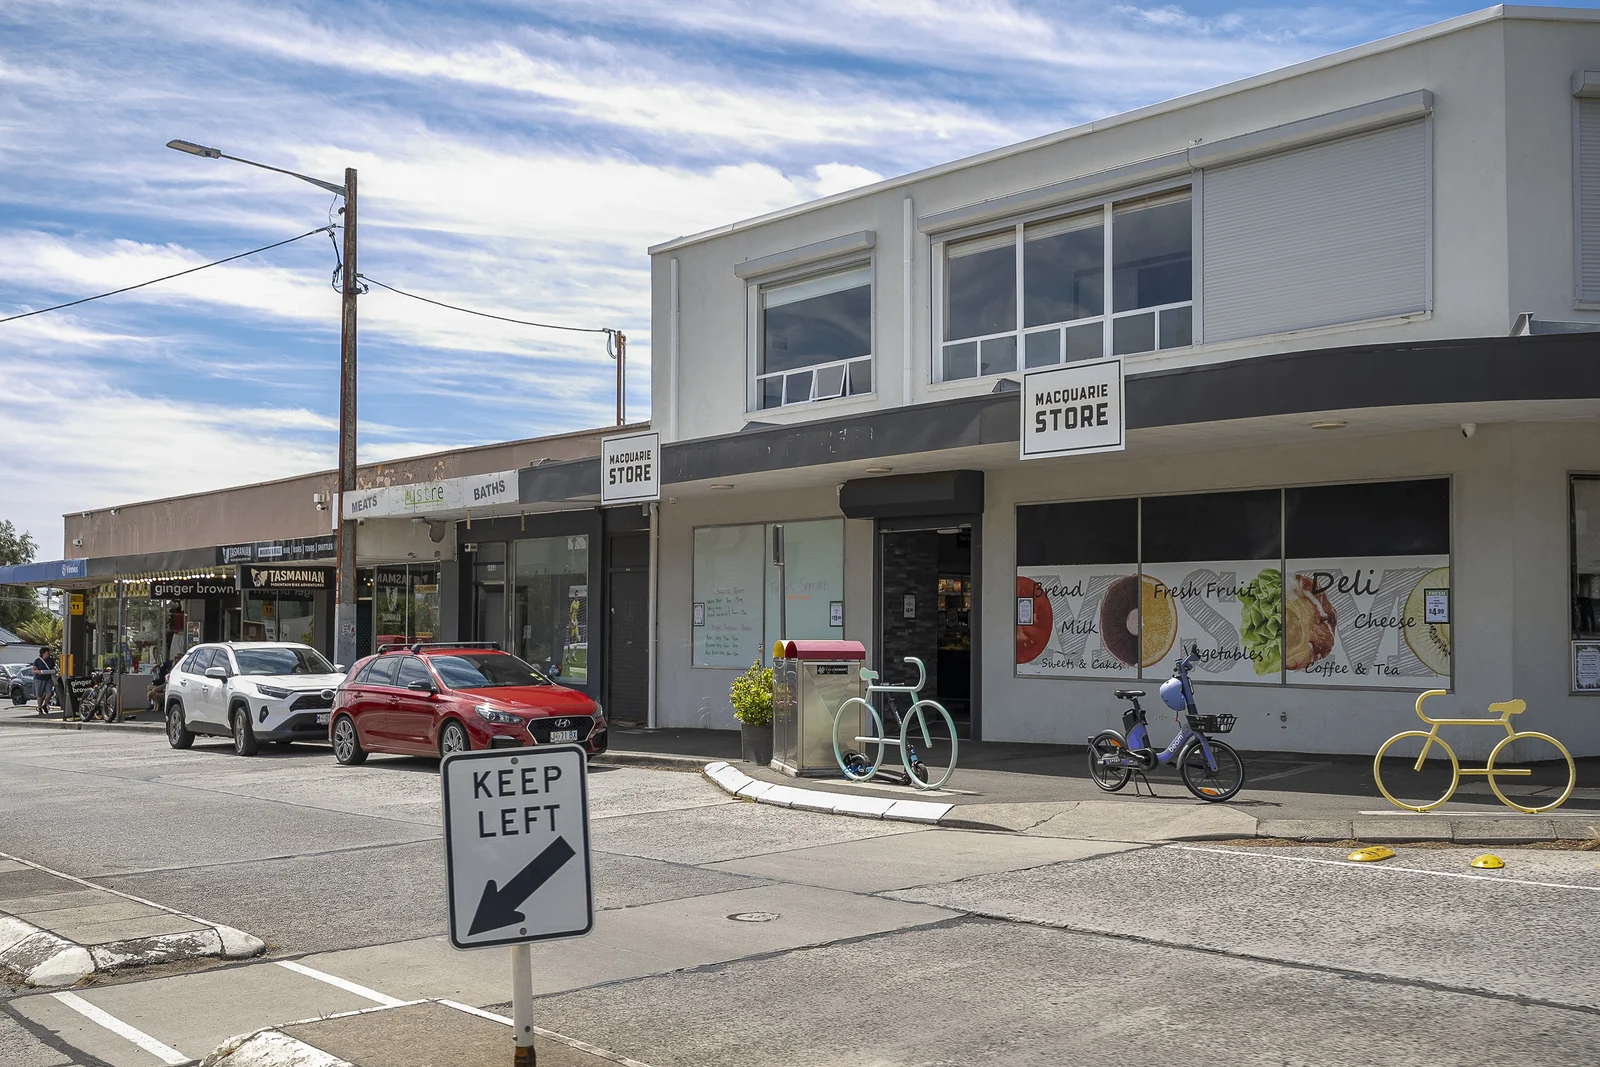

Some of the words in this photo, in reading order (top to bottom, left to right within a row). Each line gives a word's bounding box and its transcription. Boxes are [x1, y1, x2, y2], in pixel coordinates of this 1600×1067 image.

[1035, 384, 1108, 406] MACQUARIE
[1035, 402, 1108, 433] STORE
[609, 450, 651, 465] MACQUARIE
[609, 464, 651, 485] STORE
[474, 479, 506, 500] BATHS
[351, 495, 378, 514] MEATS
[269, 570, 325, 583] TASMANIAN
[1311, 569, 1380, 596] Deli
[154, 581, 194, 596] ginger
[196, 581, 234, 594] brown
[1033, 580, 1085, 598] Bread
[1154, 581, 1201, 600] Fresh
[1206, 581, 1257, 598] Fruit
[1354, 612, 1417, 629] Cheese
[1428, 607, 1445, 616] $4.99
[1061, 620, 1099, 634] Milk
[1041, 658, 1074, 669] Sweets
[1078, 658, 1087, 669] &
[1092, 658, 1123, 670] Cakes
[1305, 661, 1350, 677] Coffee
[1355, 662, 1367, 675] &
[1373, 663, 1401, 676] Tea
[71, 679, 92, 687] ginger
[1168, 734, 1184, 753] beam
[473, 765, 562, 800] KEEP
[478, 803, 561, 839] LEFT
